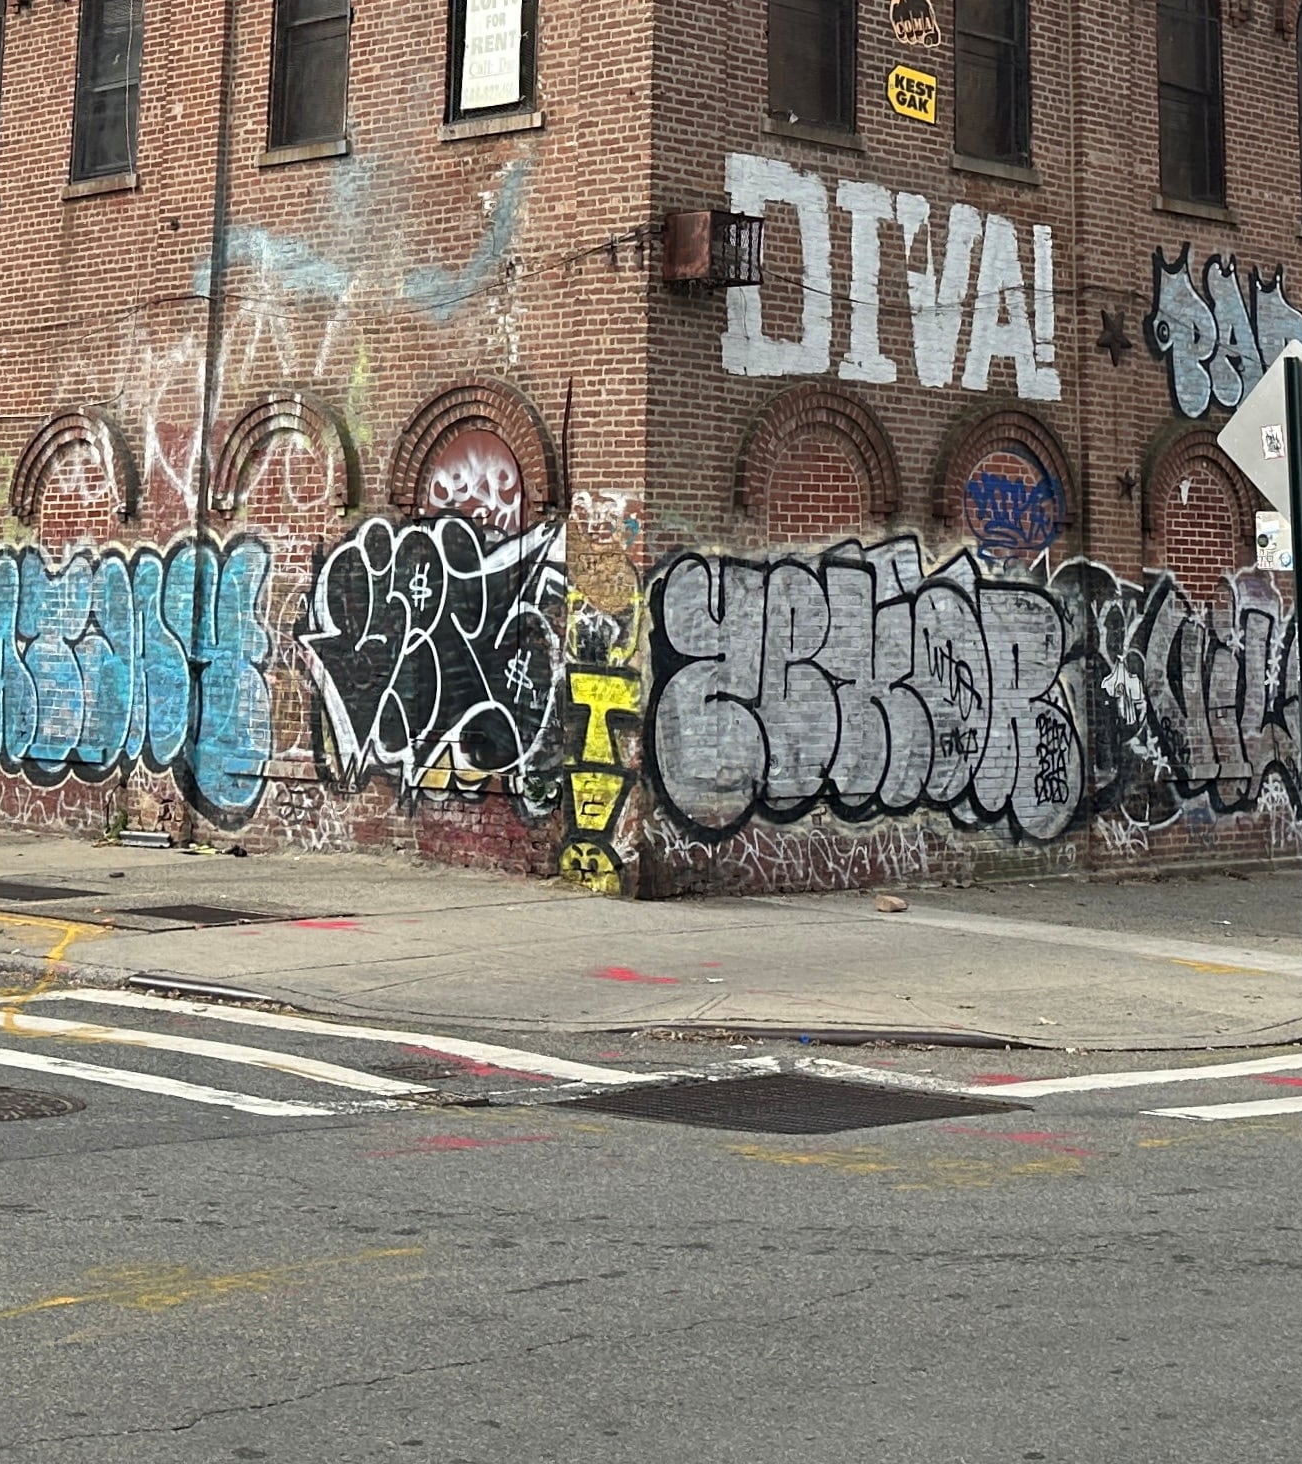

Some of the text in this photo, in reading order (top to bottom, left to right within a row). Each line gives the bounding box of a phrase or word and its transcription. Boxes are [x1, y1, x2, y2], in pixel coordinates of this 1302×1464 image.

[486, 12, 507, 28] FOR
[896, 16, 933, 36] COMA
[471, 30, 517, 56] RENT
[895, 73, 935, 100] KEST
[896, 91, 930, 114] GAK
[721, 152, 1062, 402] DIVA!
